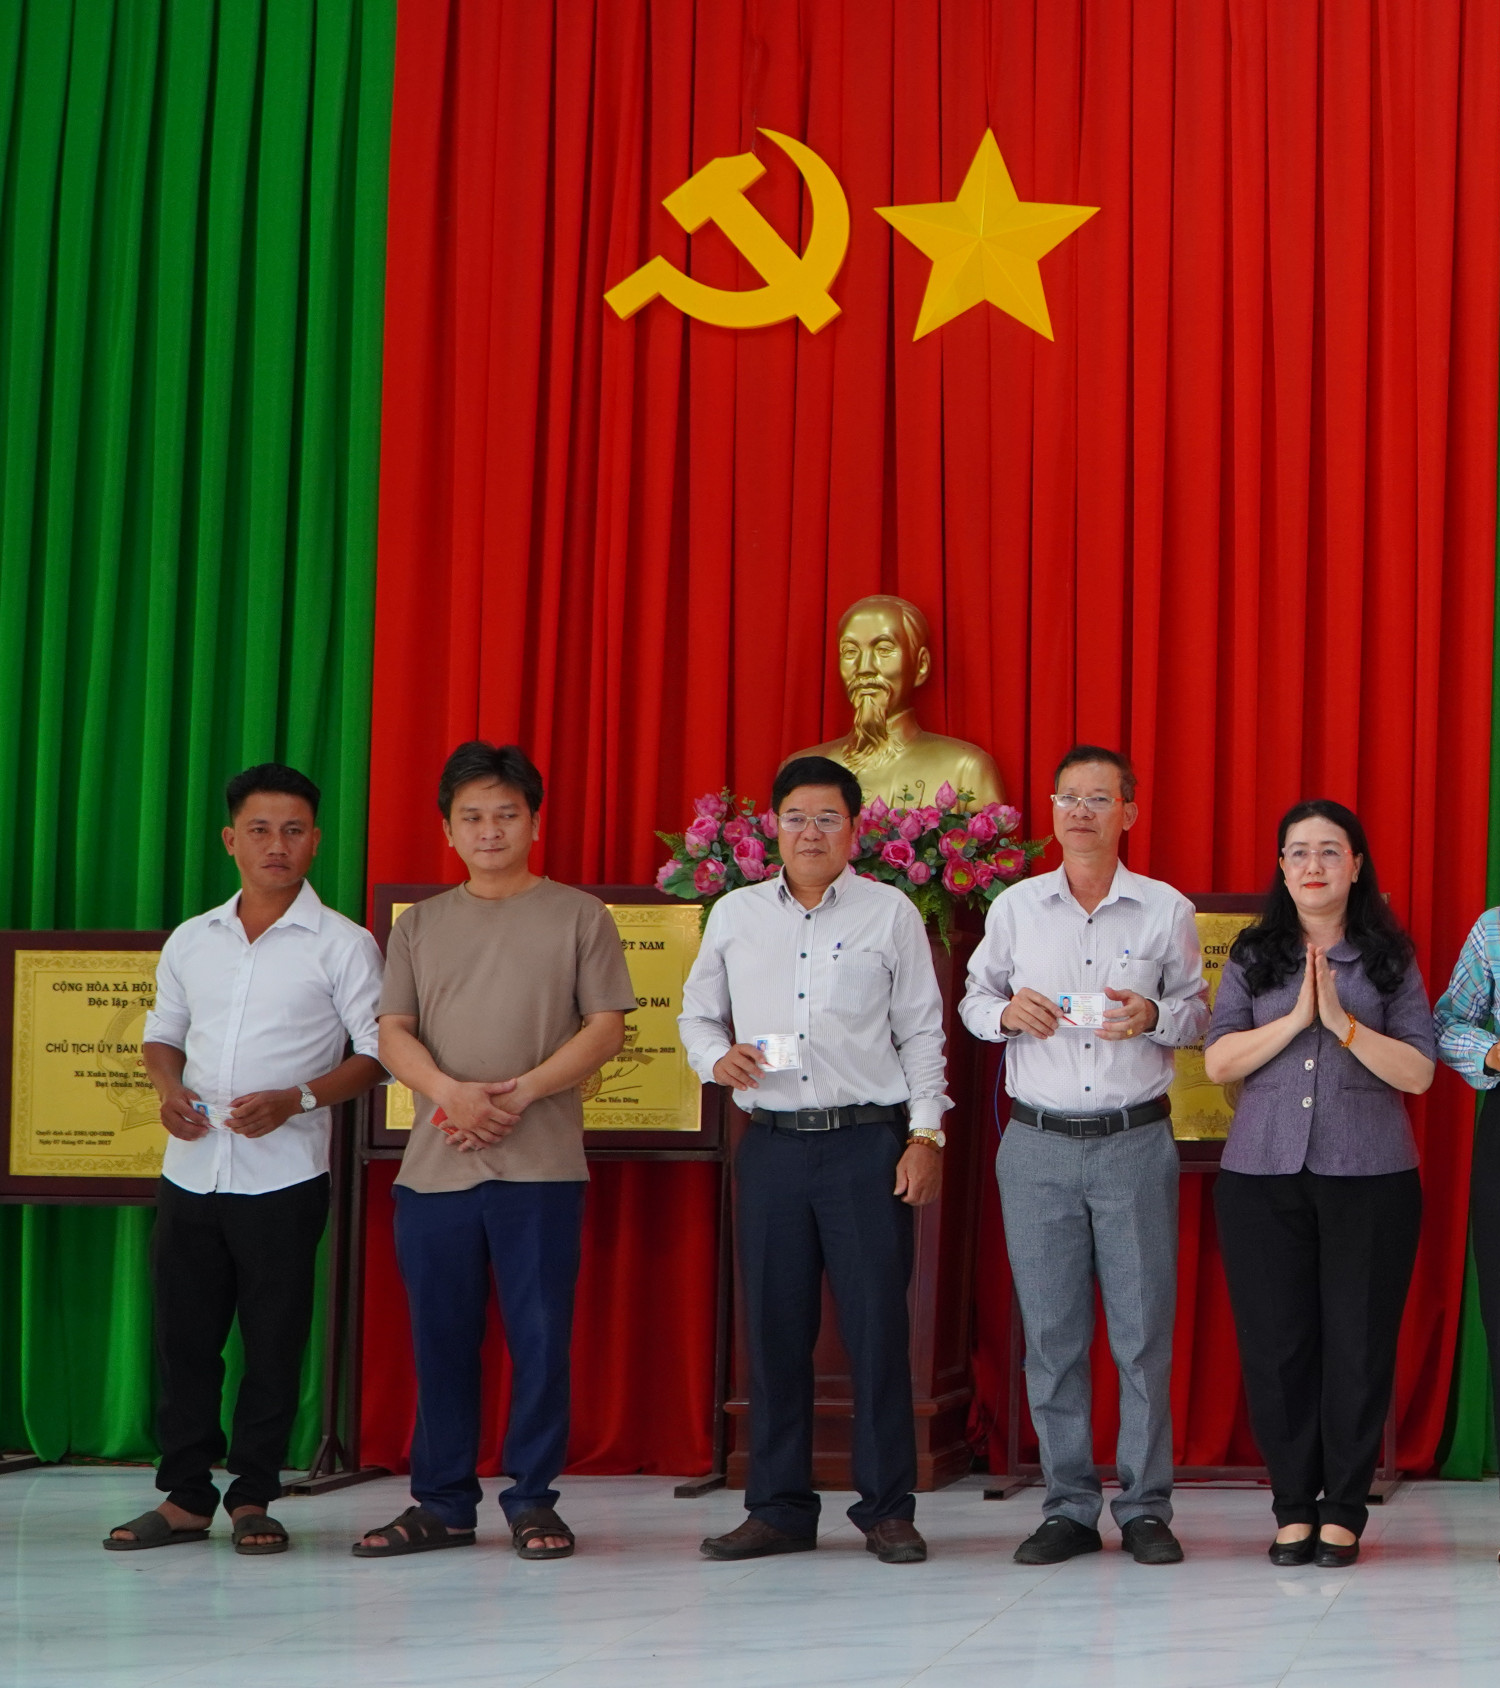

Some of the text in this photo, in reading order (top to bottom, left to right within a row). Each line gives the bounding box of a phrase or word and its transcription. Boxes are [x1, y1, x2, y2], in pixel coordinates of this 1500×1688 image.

[639, 941, 665, 950] NAM
[52, 981, 83, 993] CỘNG
[112, 981, 129, 992] XÃ
[132, 982, 152, 994] HỘI
[650, 997, 670, 1008] NAI
[45, 1040, 69, 1053] CHỦ
[71, 1043, 95, 1055] TỊCH
[98, 1040, 113, 1053] ỦY
[116, 1044, 138, 1053] BAN
[133, 1071, 148, 1079] Huy
